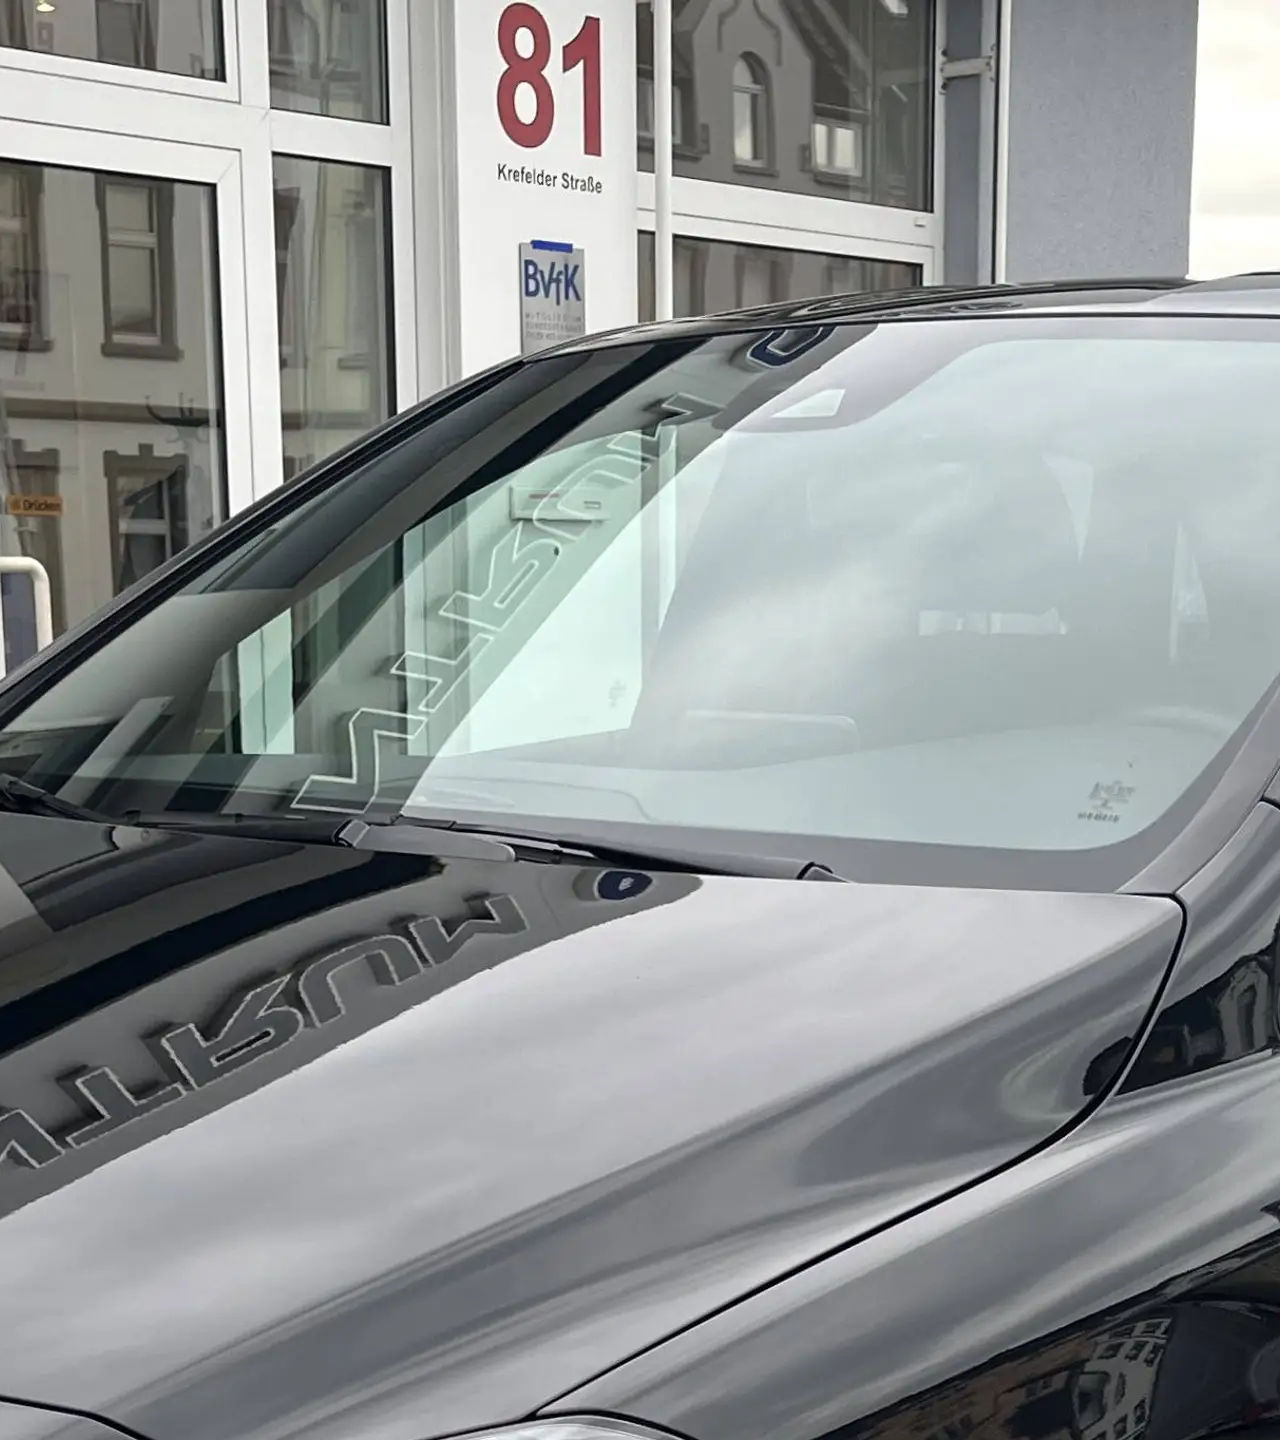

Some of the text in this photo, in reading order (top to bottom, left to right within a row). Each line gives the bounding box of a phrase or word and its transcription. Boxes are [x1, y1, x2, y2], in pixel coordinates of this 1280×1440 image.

[496, 2, 603, 157] 81
[497, 163, 603, 195] Krefelder Straße
